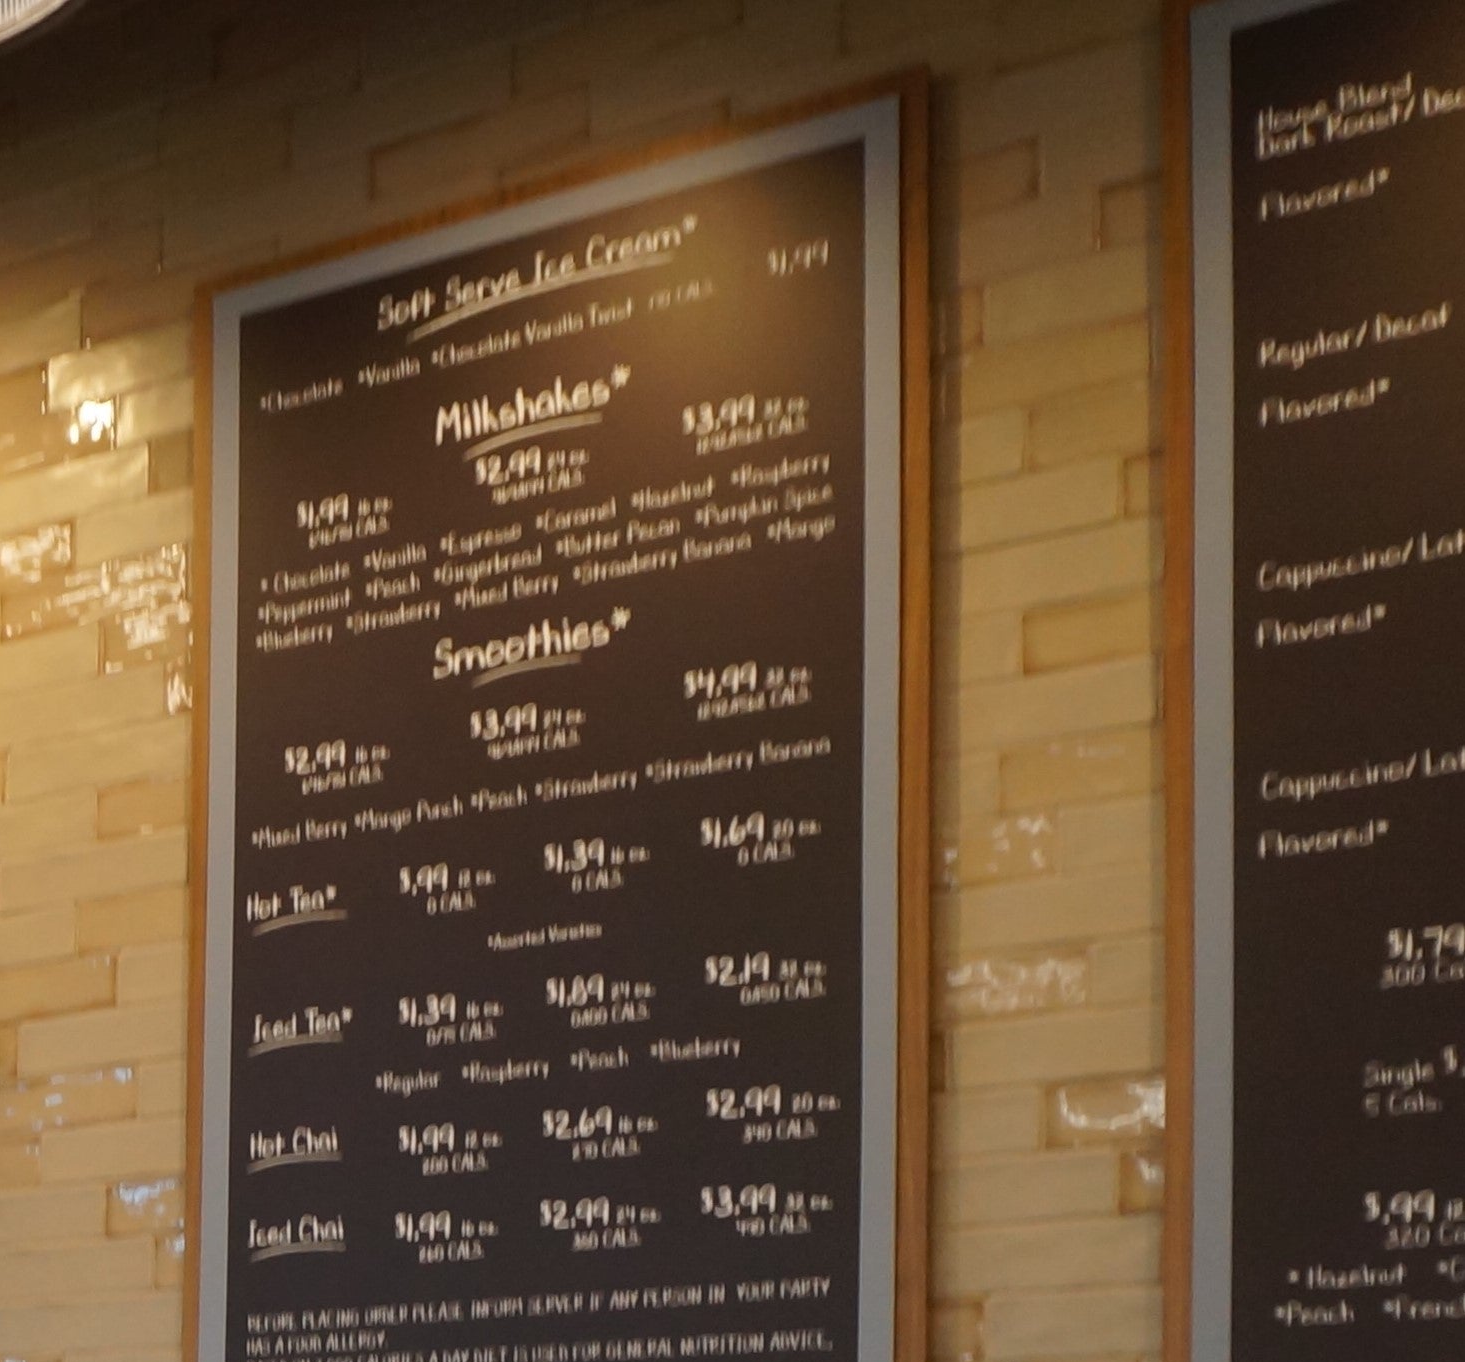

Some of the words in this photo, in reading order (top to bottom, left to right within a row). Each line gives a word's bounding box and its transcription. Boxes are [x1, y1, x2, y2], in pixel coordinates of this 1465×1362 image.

[1257, 99, 1329, 136] House
[1338, 70, 1414, 113] Blend
[1256, 120, 1316, 161] Dark
[377, 285, 436, 331] Soft
[445, 264, 520, 312] Serve
[534, 250, 576, 286] Ice
[588, 297, 632, 328] Twist
[1376, 300, 1451, 342] Decaf
[682, 394, 755, 436] $3.99
[475, 445, 541, 486] $2.99
[296, 492, 349, 528] $1.99
[372, 542, 427, 573] Vanilla
[684, 660, 757, 700] $4.99
[470, 702, 538, 742] $3.99
[284, 738, 346, 776] $2.99
[700, 810, 765, 849] $1.69
[544, 837, 604, 874] $1.39
[399, 862, 449, 897] $.99
[246, 891, 282, 923] Hot
[705, 951, 770, 986] $2.19
[253, 1012, 297, 1044] Iced
[398, 992, 456, 1028] $1.39
[706, 1083, 781, 1120] $2.99
[398, 1122, 455, 1155] $1.99
[543, 1105, 612, 1140] $2.69
[250, 1130, 285, 1160] Hot
[292, 1125, 338, 1154] Chai
[540, 1195, 610, 1230] $2.99
[701, 1183, 776, 1218] $3.99
[1363, 1189, 1435, 1227] $.99
[248, 1218, 292, 1249] Iced
[298, 1213, 344, 1243] Chai
[395, 1210, 451, 1243] $1.99
